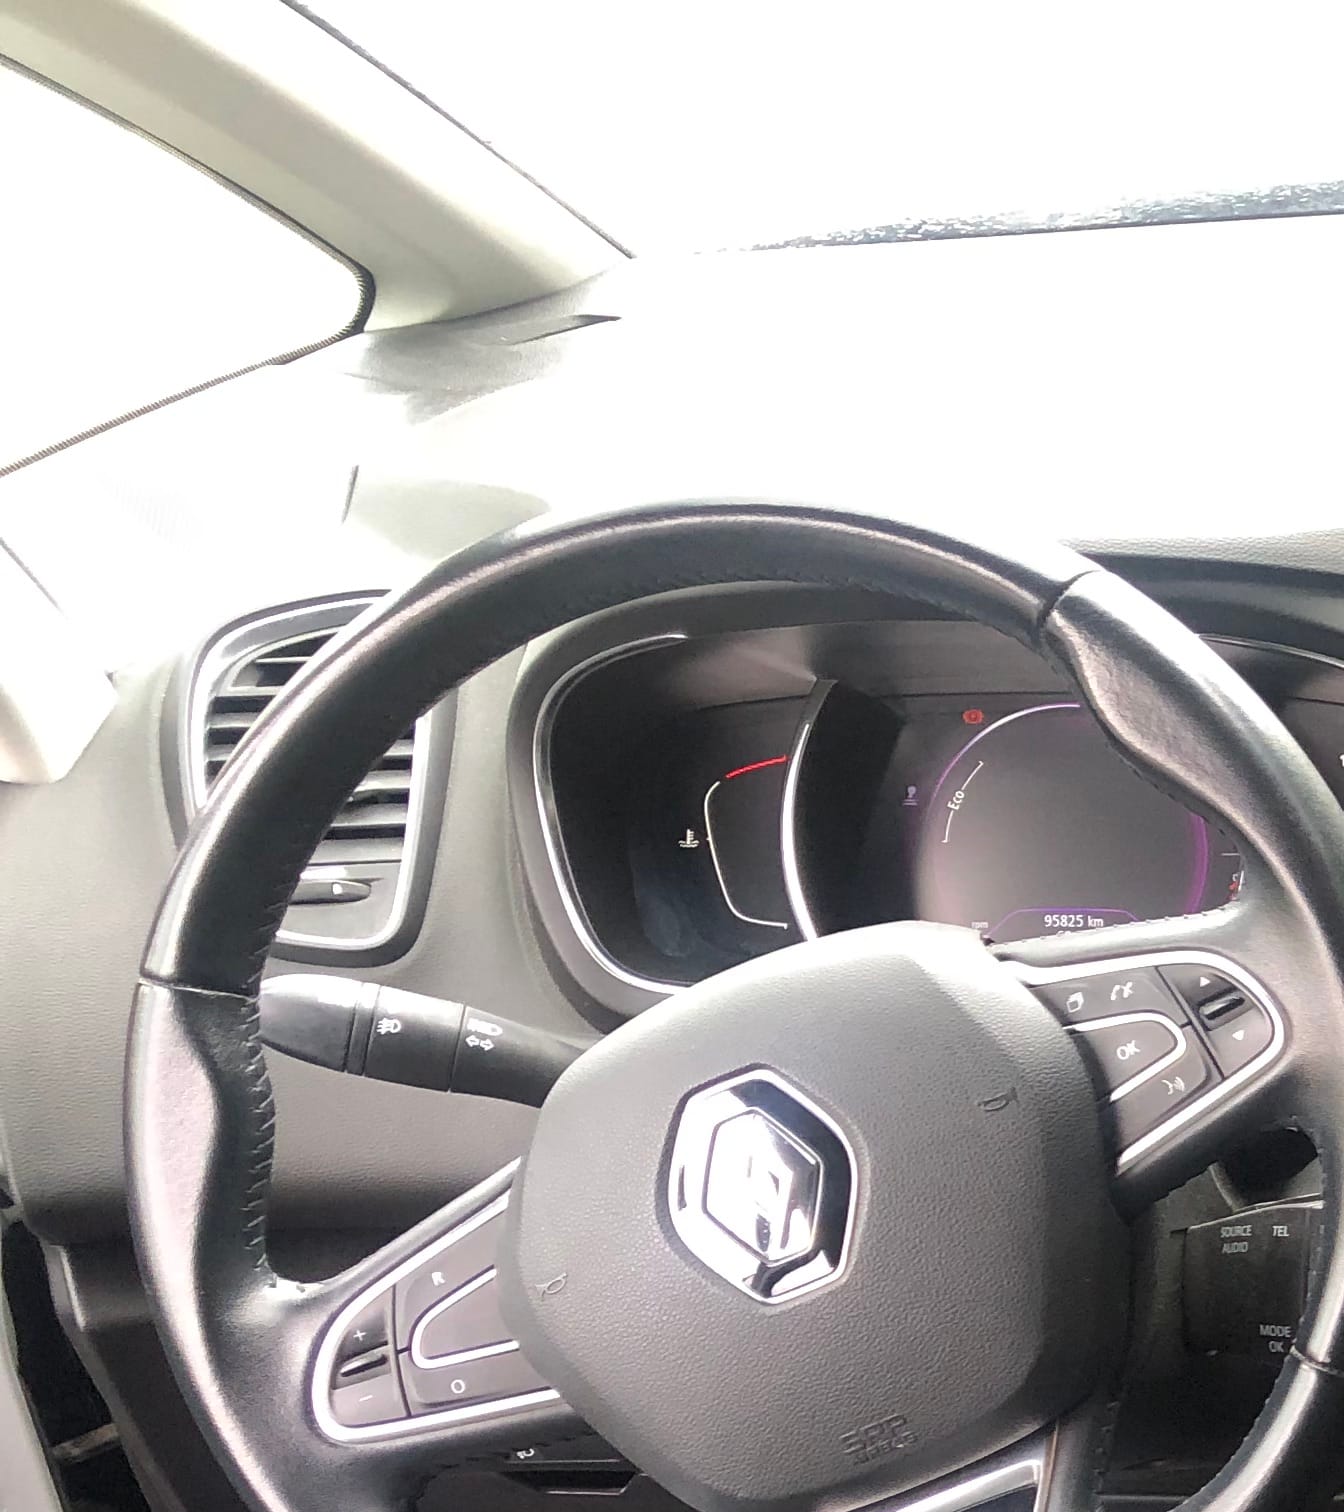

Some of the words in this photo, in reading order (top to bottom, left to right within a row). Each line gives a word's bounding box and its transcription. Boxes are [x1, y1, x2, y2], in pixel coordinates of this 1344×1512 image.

[946, 790, 965, 810] Eco
[1044, 914, 1084, 928] 95825
[1087, 915, 1104, 928] km
[1116, 1040, 1140, 1060] OK
[1220, 1224, 1253, 1238] SOURCE
[1272, 1225, 1290, 1237] TEL
[1222, 1241, 1249, 1254] AUDIO
[1260, 1324, 1292, 1338] MODE
[1268, 1340, 1285, 1353] OK
